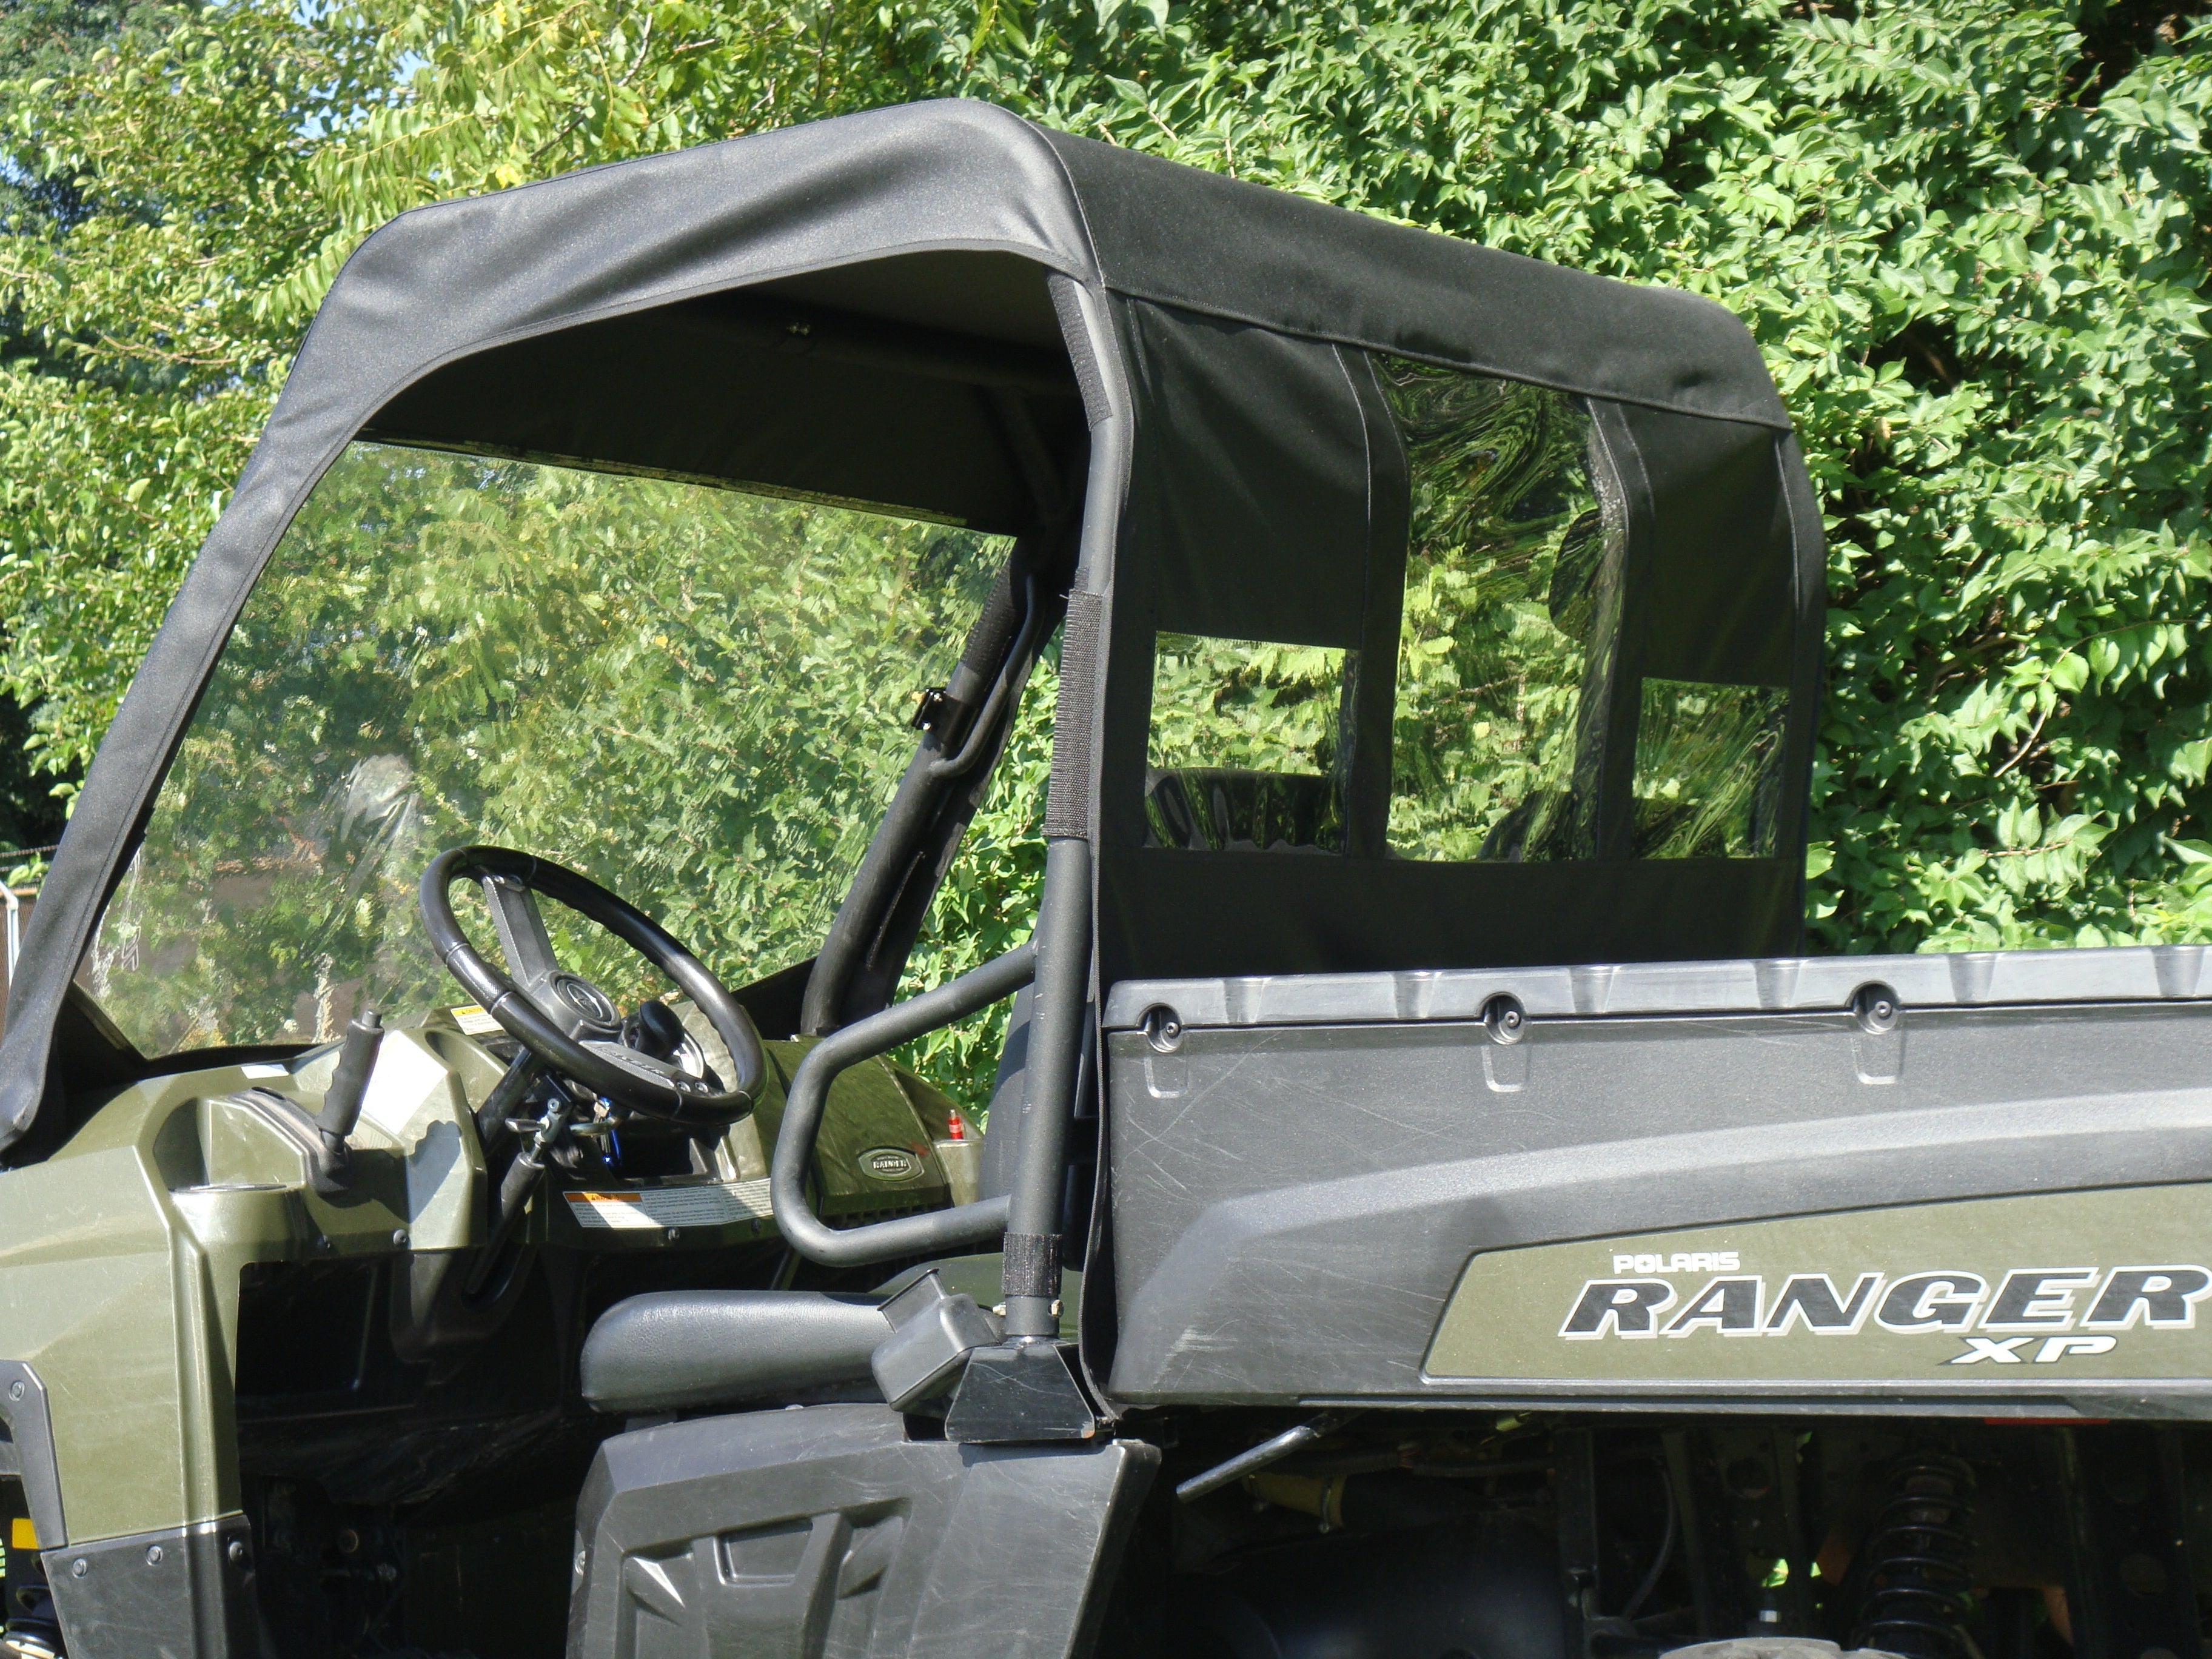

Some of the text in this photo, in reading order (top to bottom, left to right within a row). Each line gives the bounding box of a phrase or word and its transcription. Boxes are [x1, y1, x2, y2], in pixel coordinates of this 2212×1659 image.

[873, 1160, 907, 1169] RANGER
[1613, 1252, 1740, 1274] POLARIS
[1558, 1264, 2212, 1339] RANGER
[1943, 1336, 2117, 1364] XP
